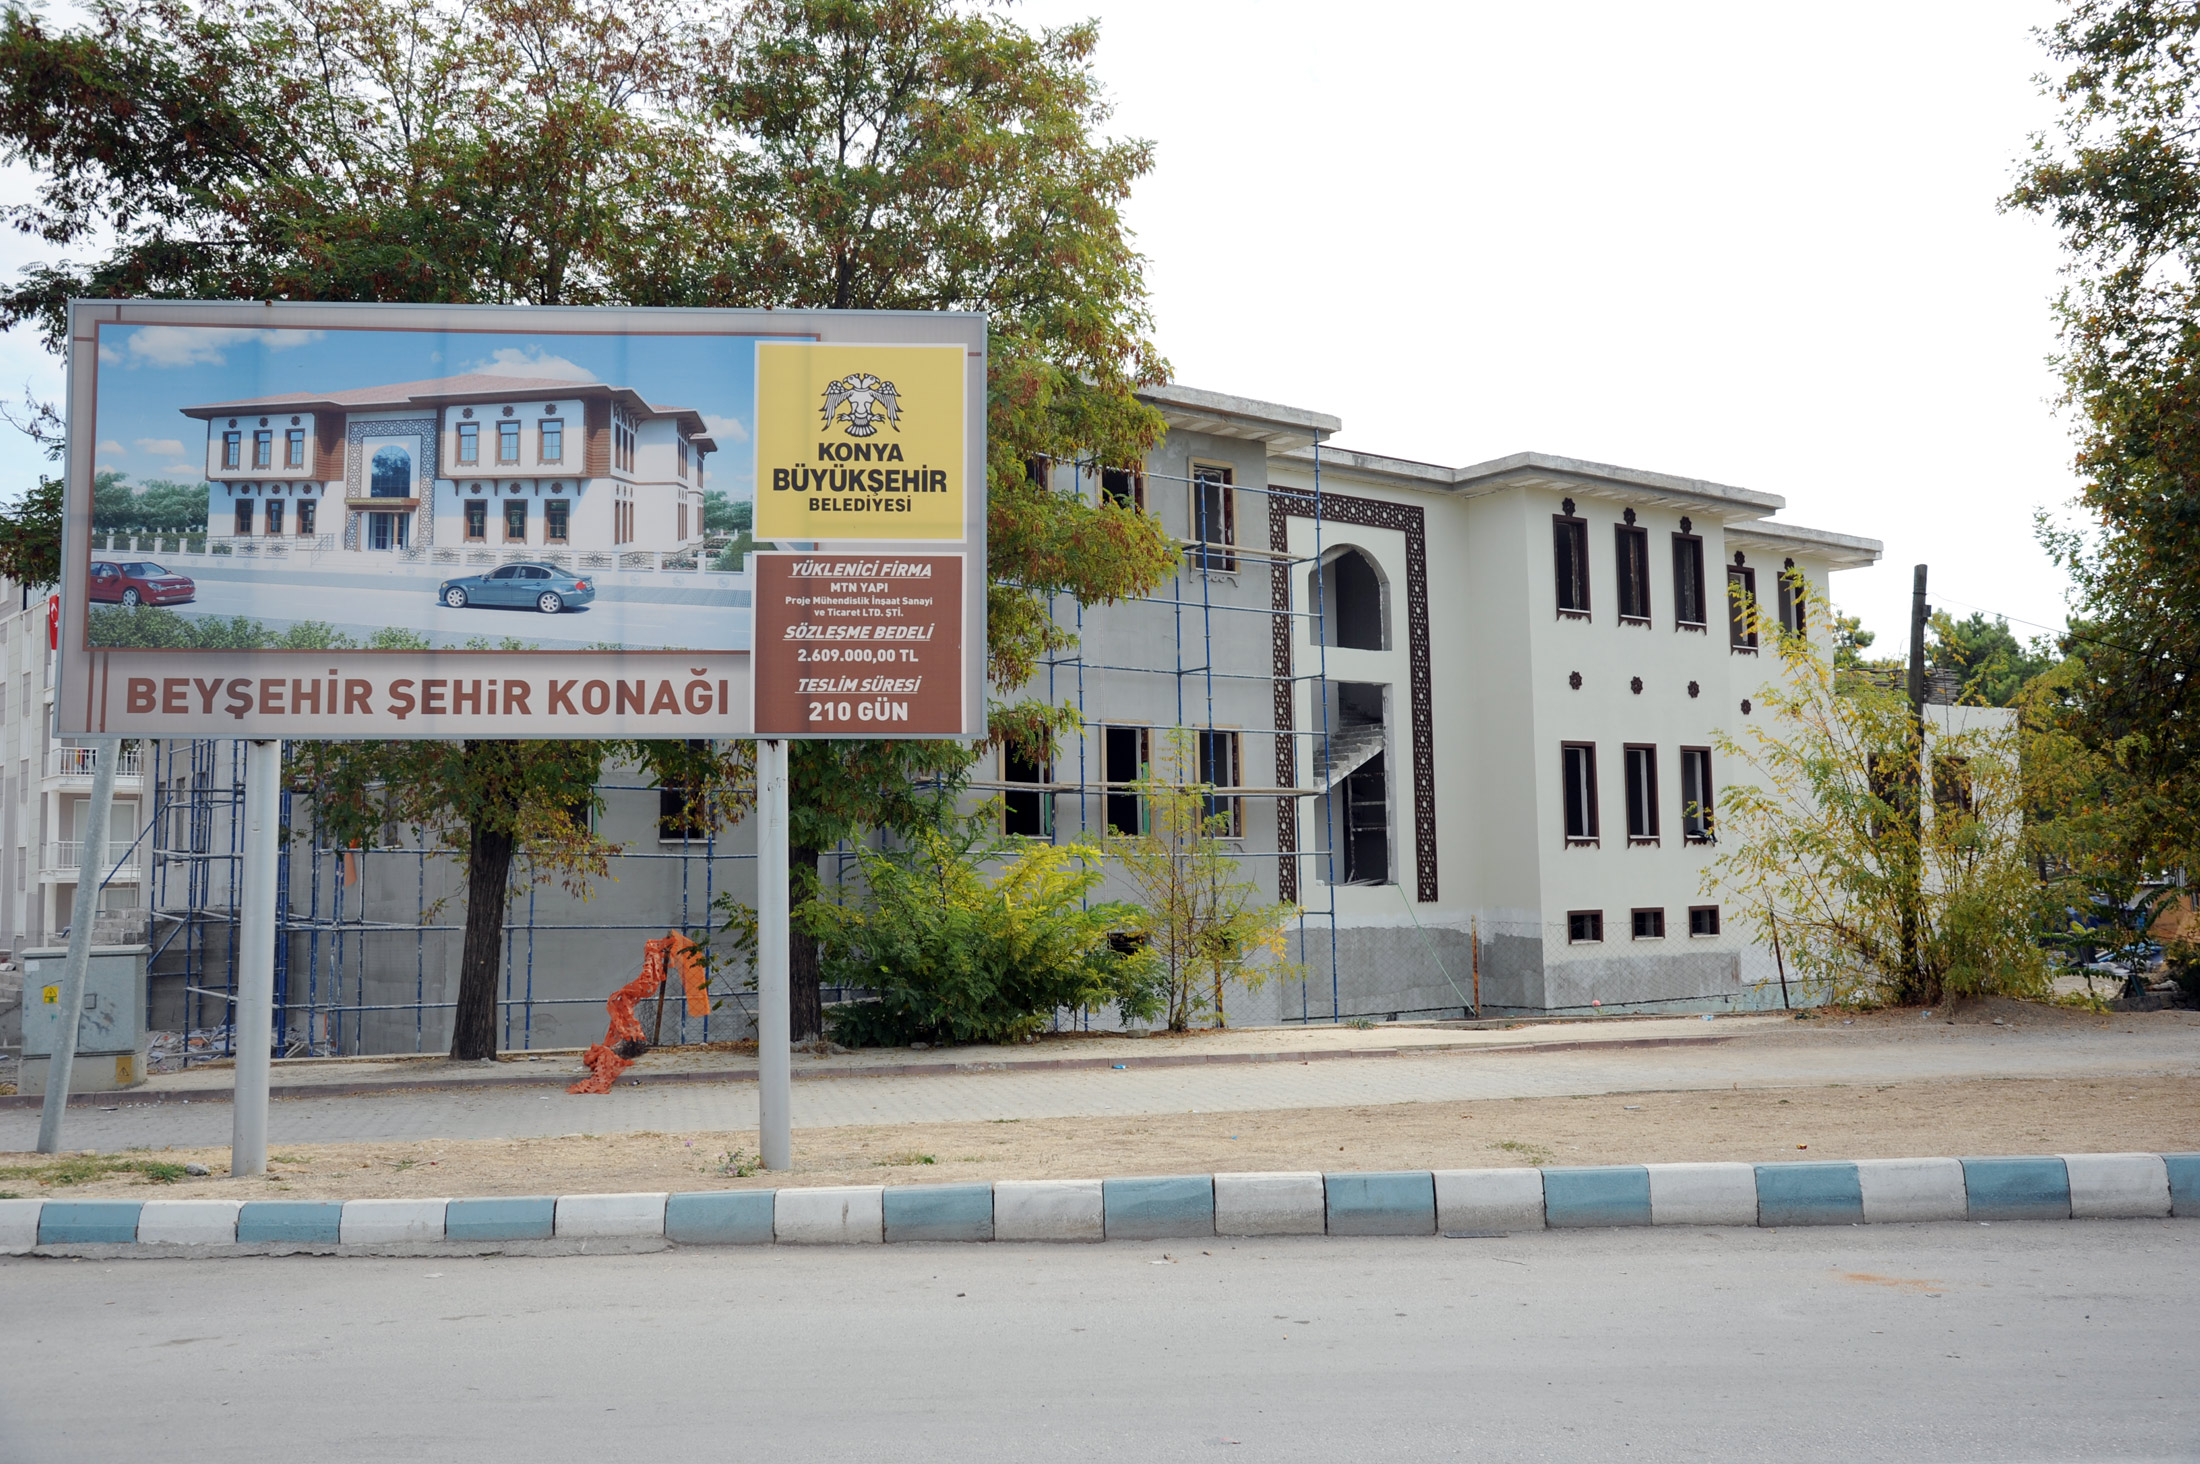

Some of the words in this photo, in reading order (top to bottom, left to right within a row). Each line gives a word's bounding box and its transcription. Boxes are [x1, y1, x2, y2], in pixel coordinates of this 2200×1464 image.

[818, 442, 904, 462] KONYA
[773, 463, 947, 496] BÜYÜKŞEHİR
[809, 495, 912, 512] BELEDİYESİ
[791, 560, 880, 577] YÜKLENİCİ
[880, 560, 932, 577] FİRMA
[830, 583, 857, 592] MTN
[860, 583, 888, 593] YAPI
[785, 596, 810, 606] Proje
[812, 596, 869, 605] Mühendislik
[872, 595, 900, 606] İnşaat
[902, 597, 933, 606] Sanayi
[828, 608, 860, 616] Ticaret
[885, 607, 904, 618] ŞTİ.
[784, 622, 872, 640] SÖZLEŞME
[873, 623, 936, 640] BEDELİ
[797, 648, 896, 664] 2.609.000,00
[900, 650, 919, 662] TL
[798, 676, 859, 692] TESLİM
[860, 676, 922, 692] SÜRESİ
[126, 668, 374, 720] BEYŞEHİR
[548, 668, 728, 716] KONAĞI
[808, 702, 851, 721] 210
[857, 696, 908, 721] GÜN
